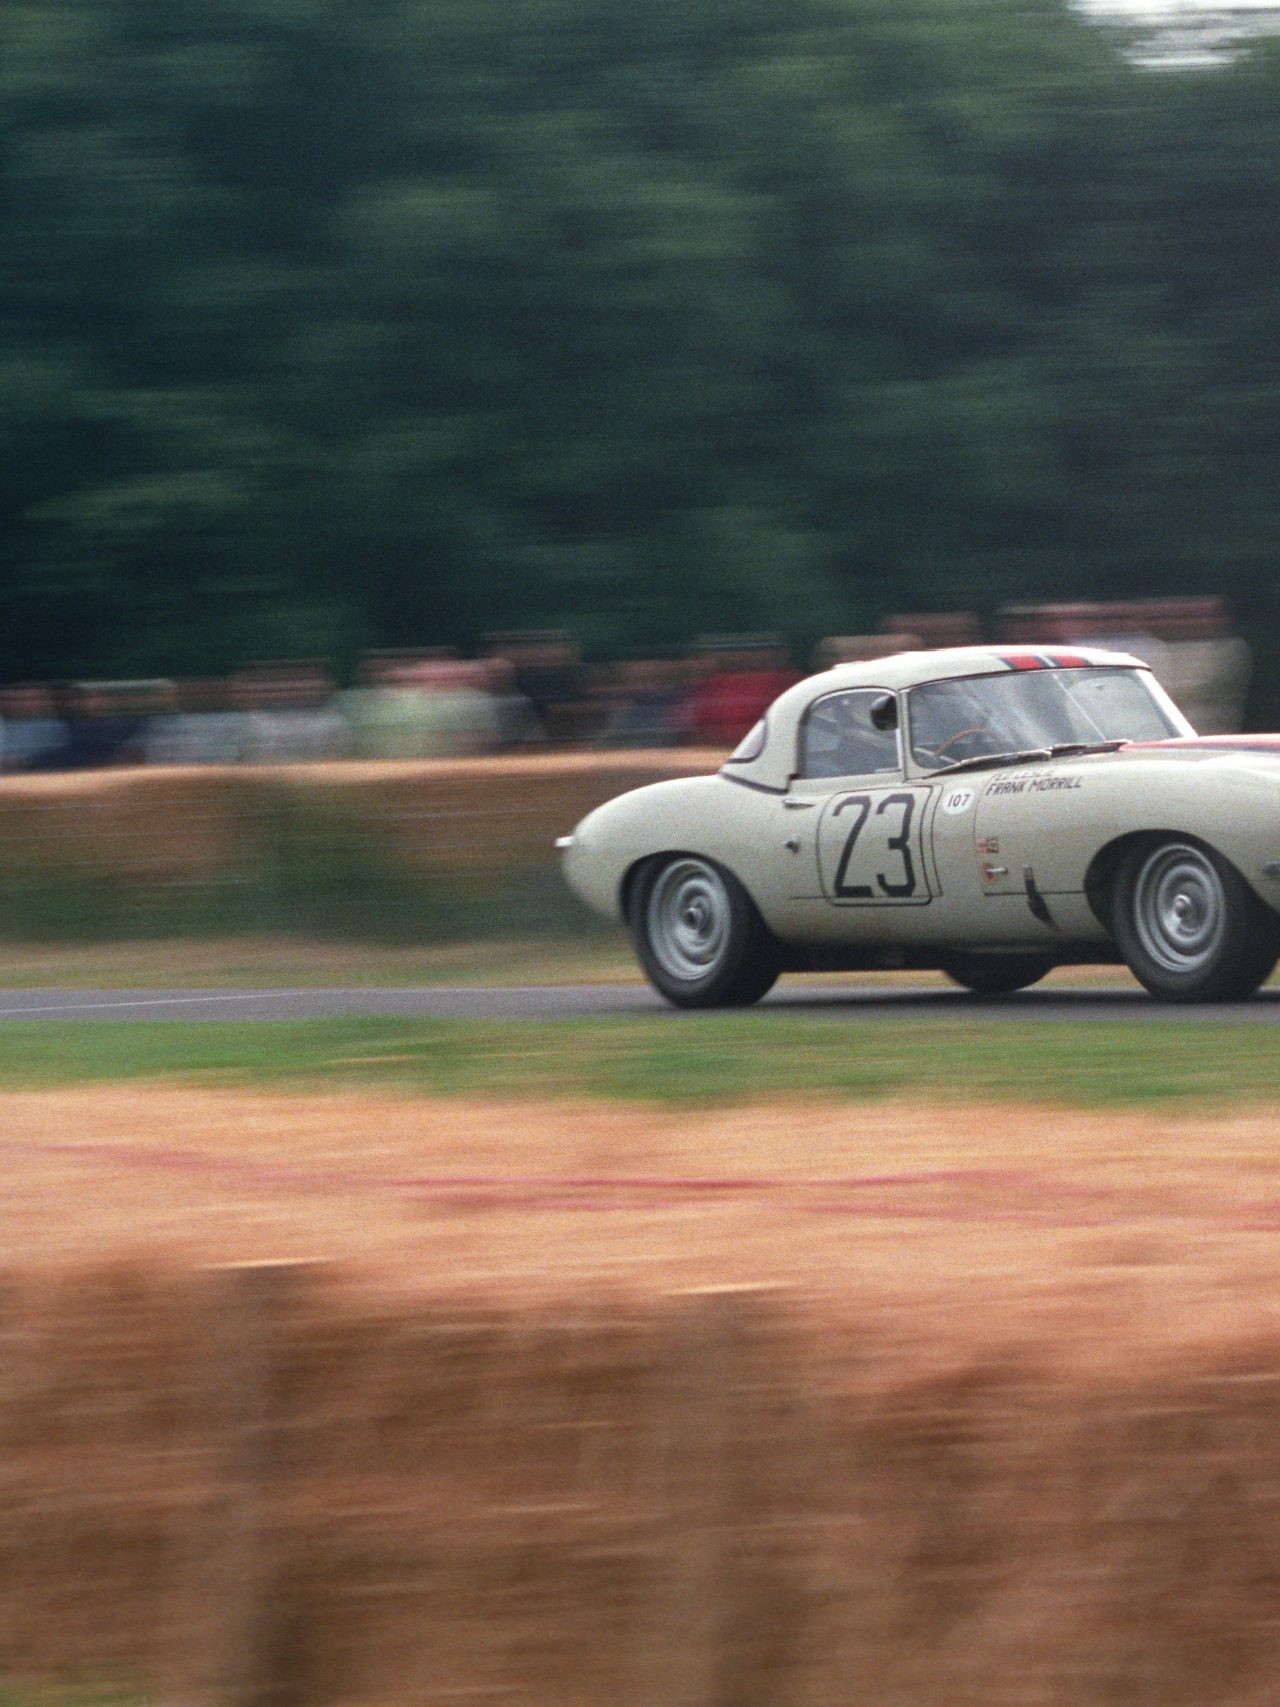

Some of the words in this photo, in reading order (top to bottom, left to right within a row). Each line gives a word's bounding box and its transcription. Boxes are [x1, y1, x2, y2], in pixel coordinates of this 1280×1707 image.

[985, 780, 1028, 796] FRANK
[1027, 776, 1083, 793] MORRILL
[947, 793, 972, 808] 107
[831, 793, 914, 898] 23
